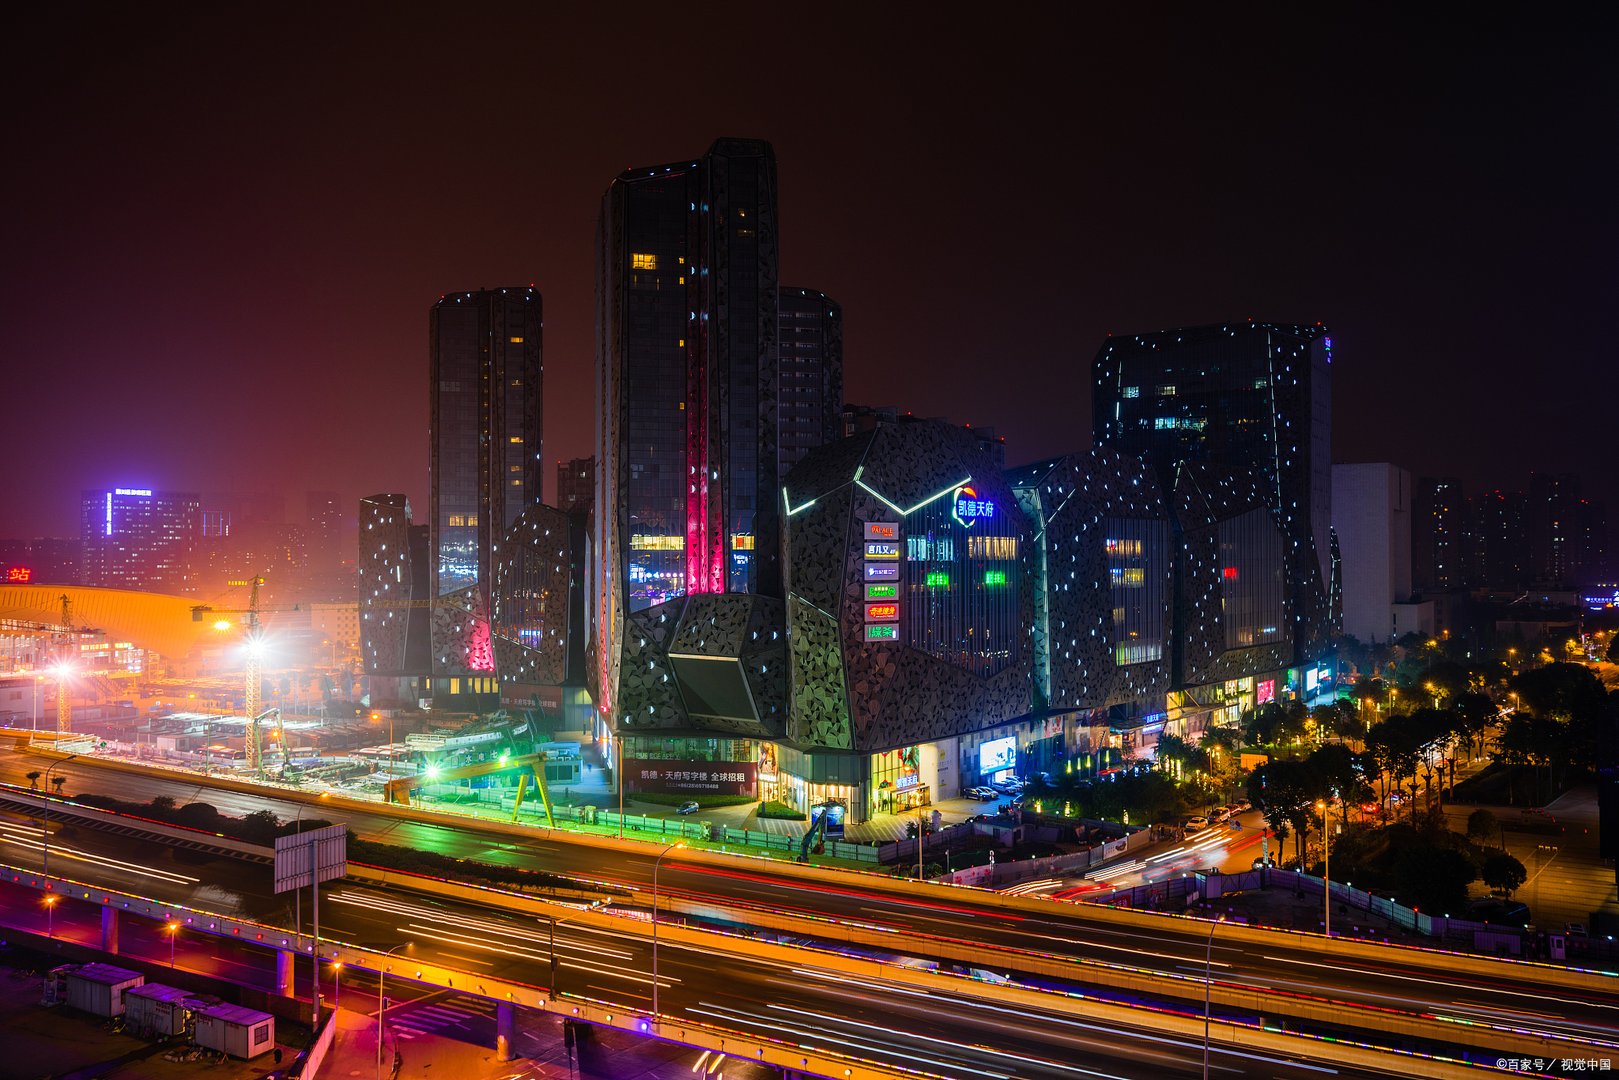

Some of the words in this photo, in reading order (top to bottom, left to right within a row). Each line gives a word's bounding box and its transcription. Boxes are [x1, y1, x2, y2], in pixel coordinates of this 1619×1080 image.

[958, 500, 993, 517] 凯德天府
[868, 545, 889, 554] 言几又
[10, 568, 31, 580] 站
[711, 772, 745, 782] 全球招租
